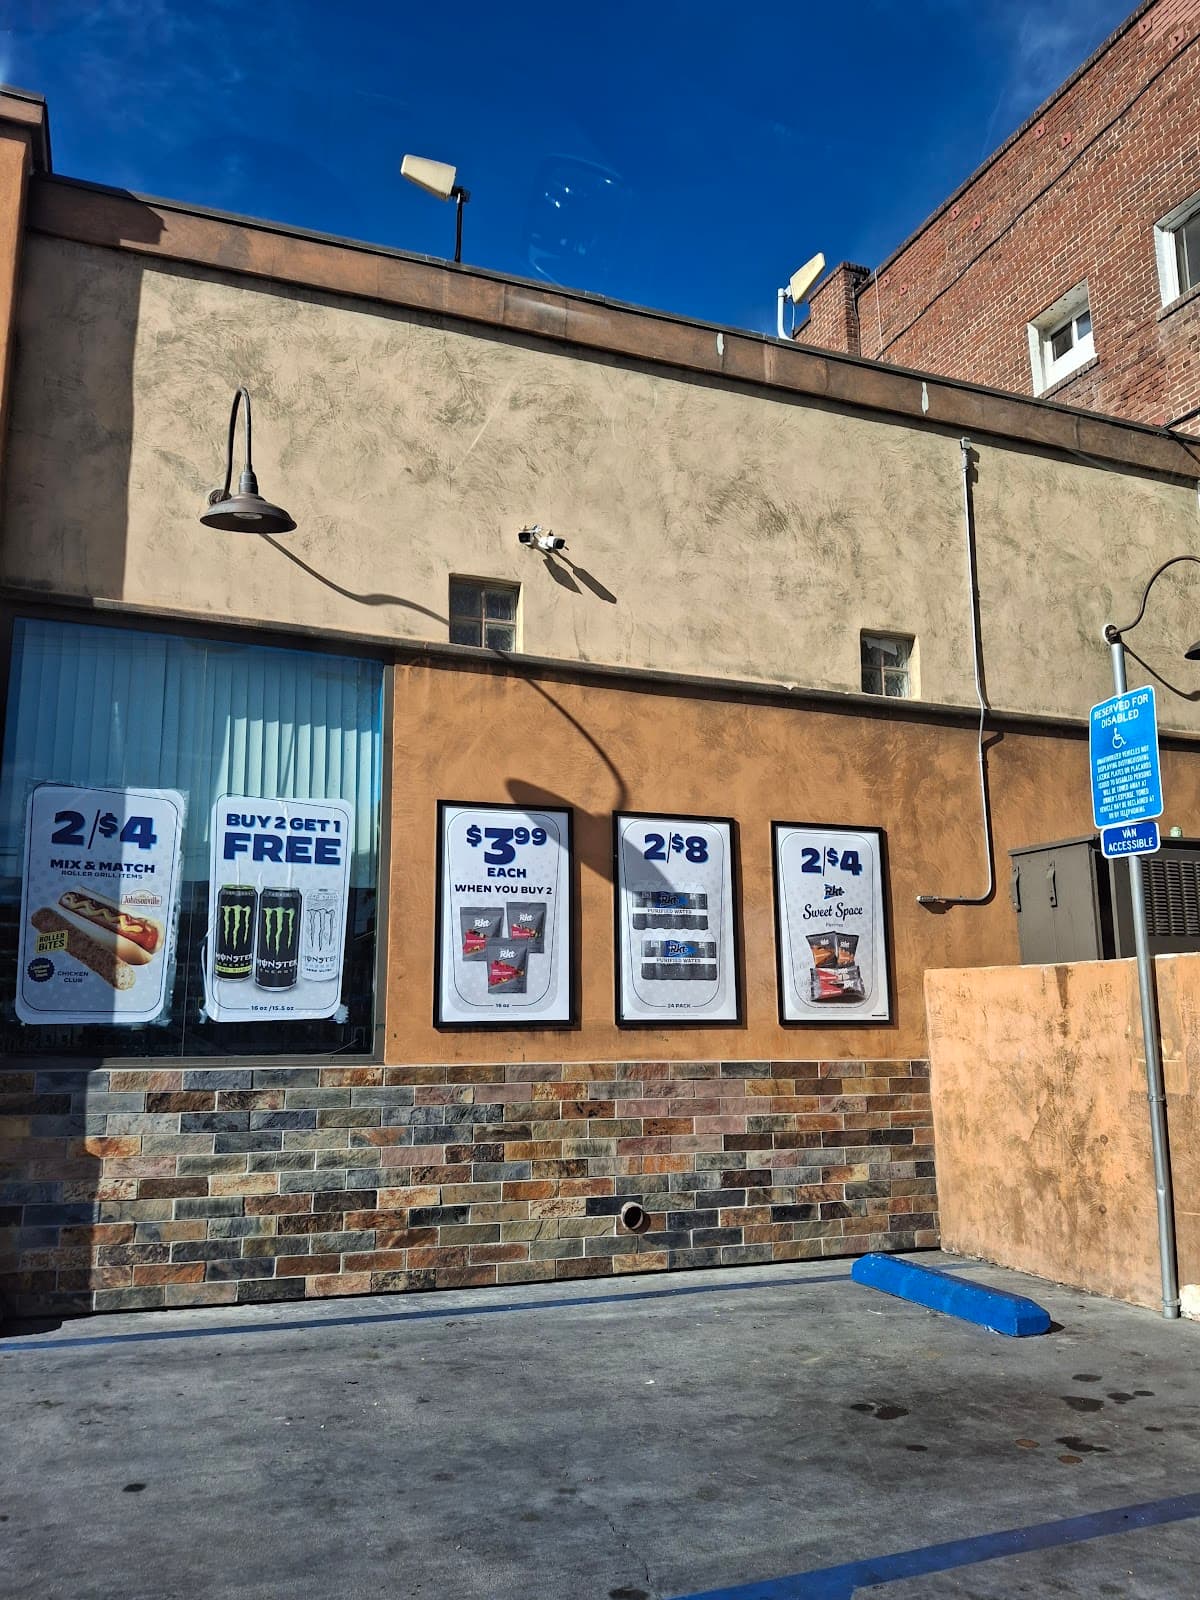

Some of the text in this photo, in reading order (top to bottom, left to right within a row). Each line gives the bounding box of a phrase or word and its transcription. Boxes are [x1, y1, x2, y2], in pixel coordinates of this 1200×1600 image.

[1094, 693, 1148, 720] RESERVED FOR
[1101, 709, 1139, 728] DISABLED
[51, 809, 157, 850] 2/$4
[226, 813, 341, 833] BUY 2 GET 1
[1122, 828, 1137, 839] VAN
[223, 832, 341, 866] FREE
[644, 832, 709, 864] 2/$8
[1108, 837, 1154, 852] ACCESSIBLE
[50, 859, 155, 873] MIX & MATCH
[801, 846, 863, 876] 2/$4
[487, 868, 527, 878] EACH
[455, 884, 553, 895] WHEN YOU BUY 2
[123, 896, 160, 905] Johnsonville
[803, 902, 863, 921] Sweet Space
[40, 933, 65, 943] ROLLER
[499, 949, 516, 958] Rkt
